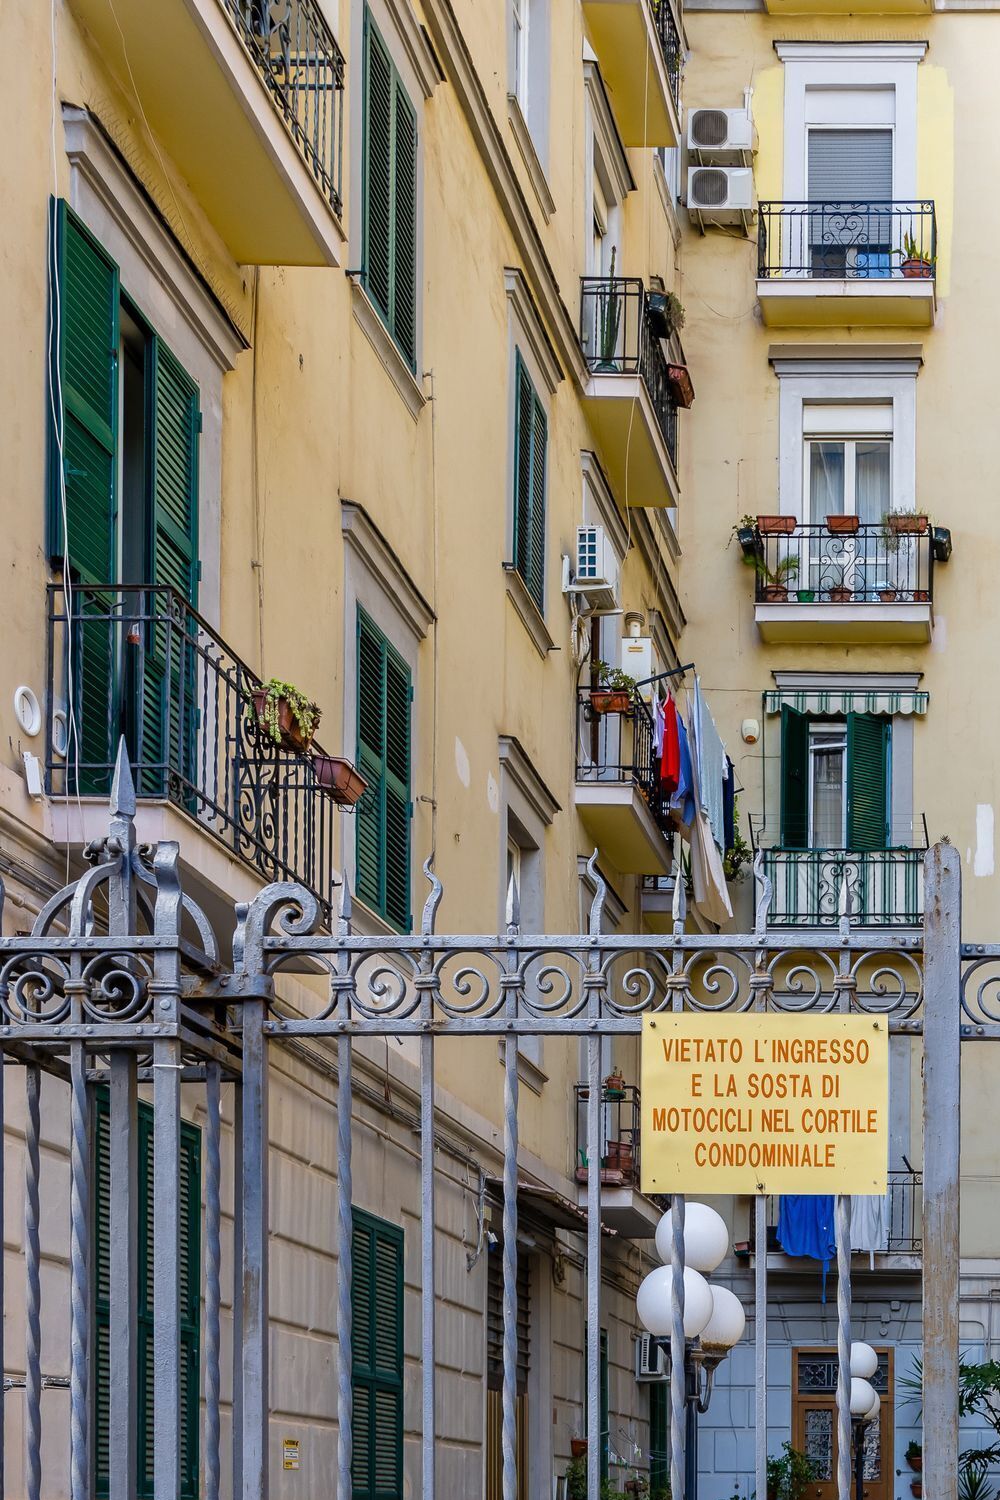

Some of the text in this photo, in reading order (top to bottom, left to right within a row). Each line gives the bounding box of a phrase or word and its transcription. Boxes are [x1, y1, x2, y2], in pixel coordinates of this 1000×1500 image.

[663, 1039, 869, 1064] VIETATO L'INGRESSO
[691, 1073, 840, 1098] E LA SOSTA DI
[652, 1107, 877, 1133] MOTOCICLI NEL CORTILE
[694, 1142, 835, 1167] CONDOMINIALE
